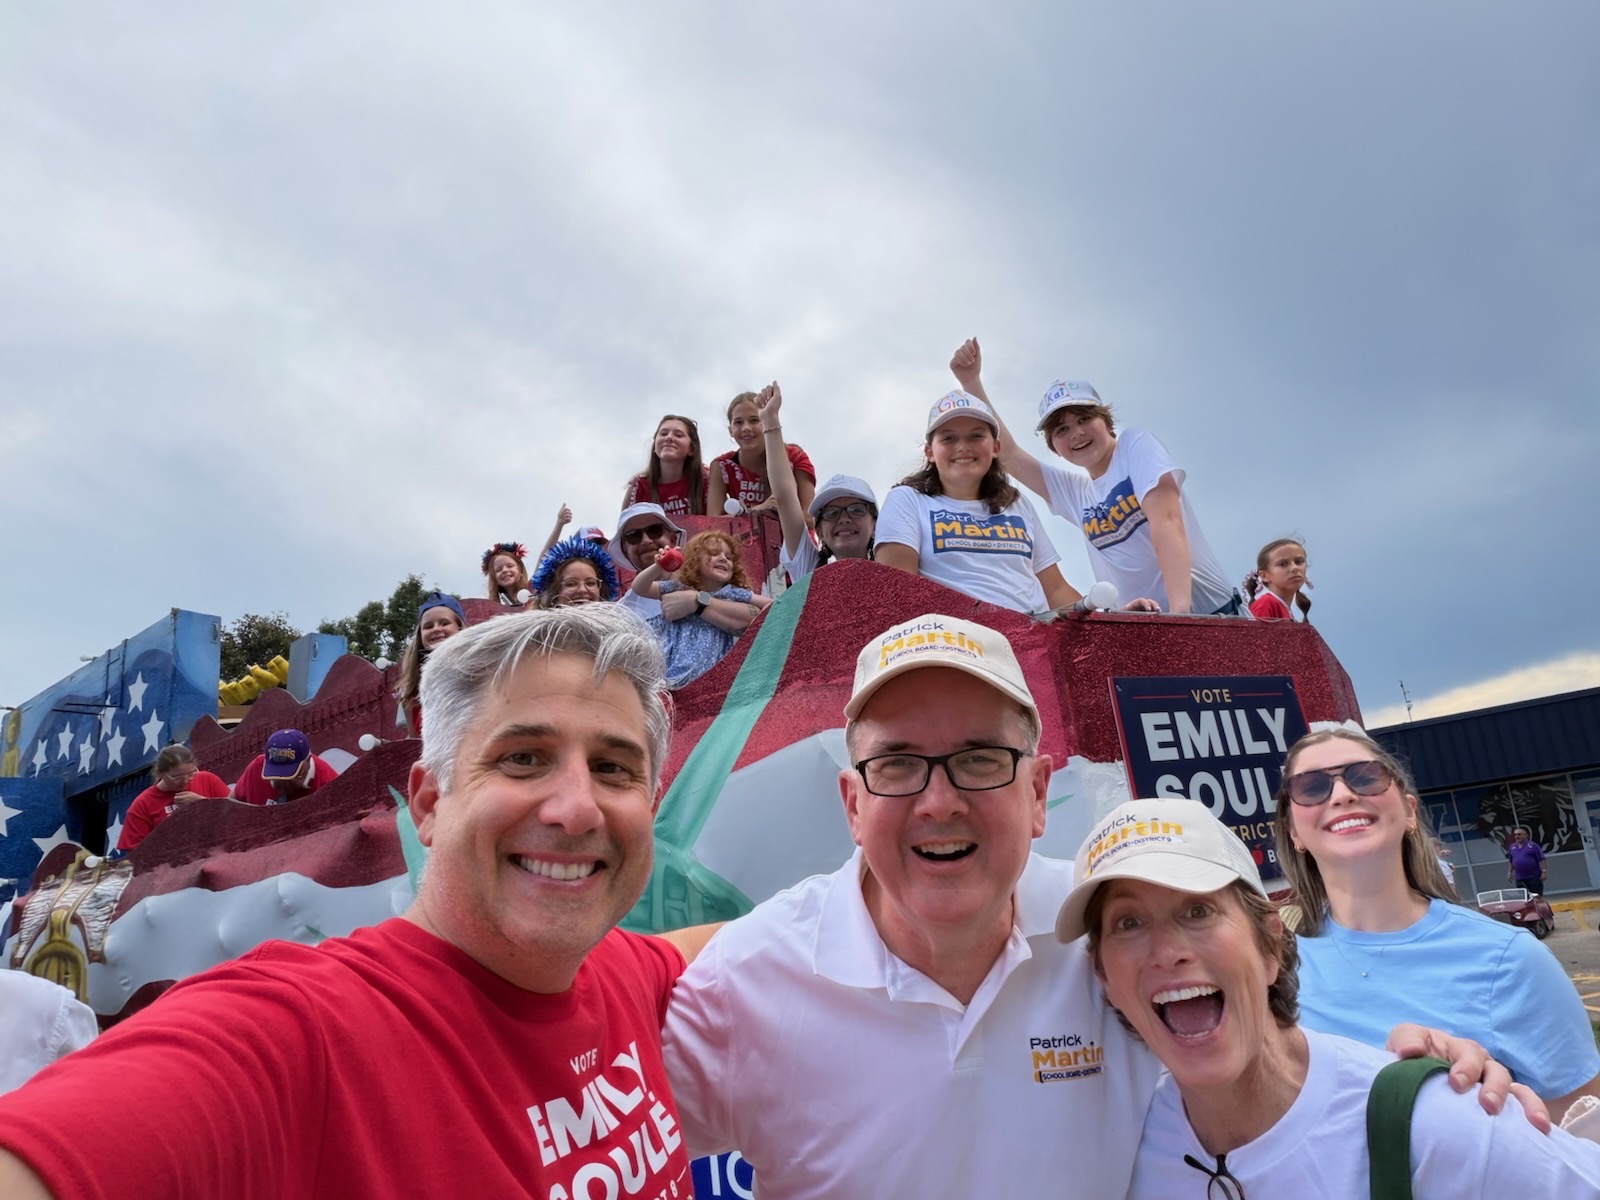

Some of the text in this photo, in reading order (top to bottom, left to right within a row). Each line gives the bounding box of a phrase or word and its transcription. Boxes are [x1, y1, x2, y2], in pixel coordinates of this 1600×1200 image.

[739, 491, 764, 502] SOU
[740, 480, 764, 492] EMI
[935, 521, 1031, 542] Martin
[997, 542, 1020, 550] DISTRICT
[881, 631, 984, 659] Martin
[882, 622, 944, 646] Patrick
[1191, 688, 1232, 704] VOTE
[1140, 708, 1288, 762] EMILY
[1155, 766, 1286, 820] SOUL
[1087, 817, 1184, 868] Martin
[1088, 814, 1137, 851] Patrick
[1030, 1034, 1082, 1050] Patrick
[1032, 1041, 1104, 1069] Martin
[570, 1048, 598, 1076] VOTE
[526, 1041, 647, 1168] EMILY
